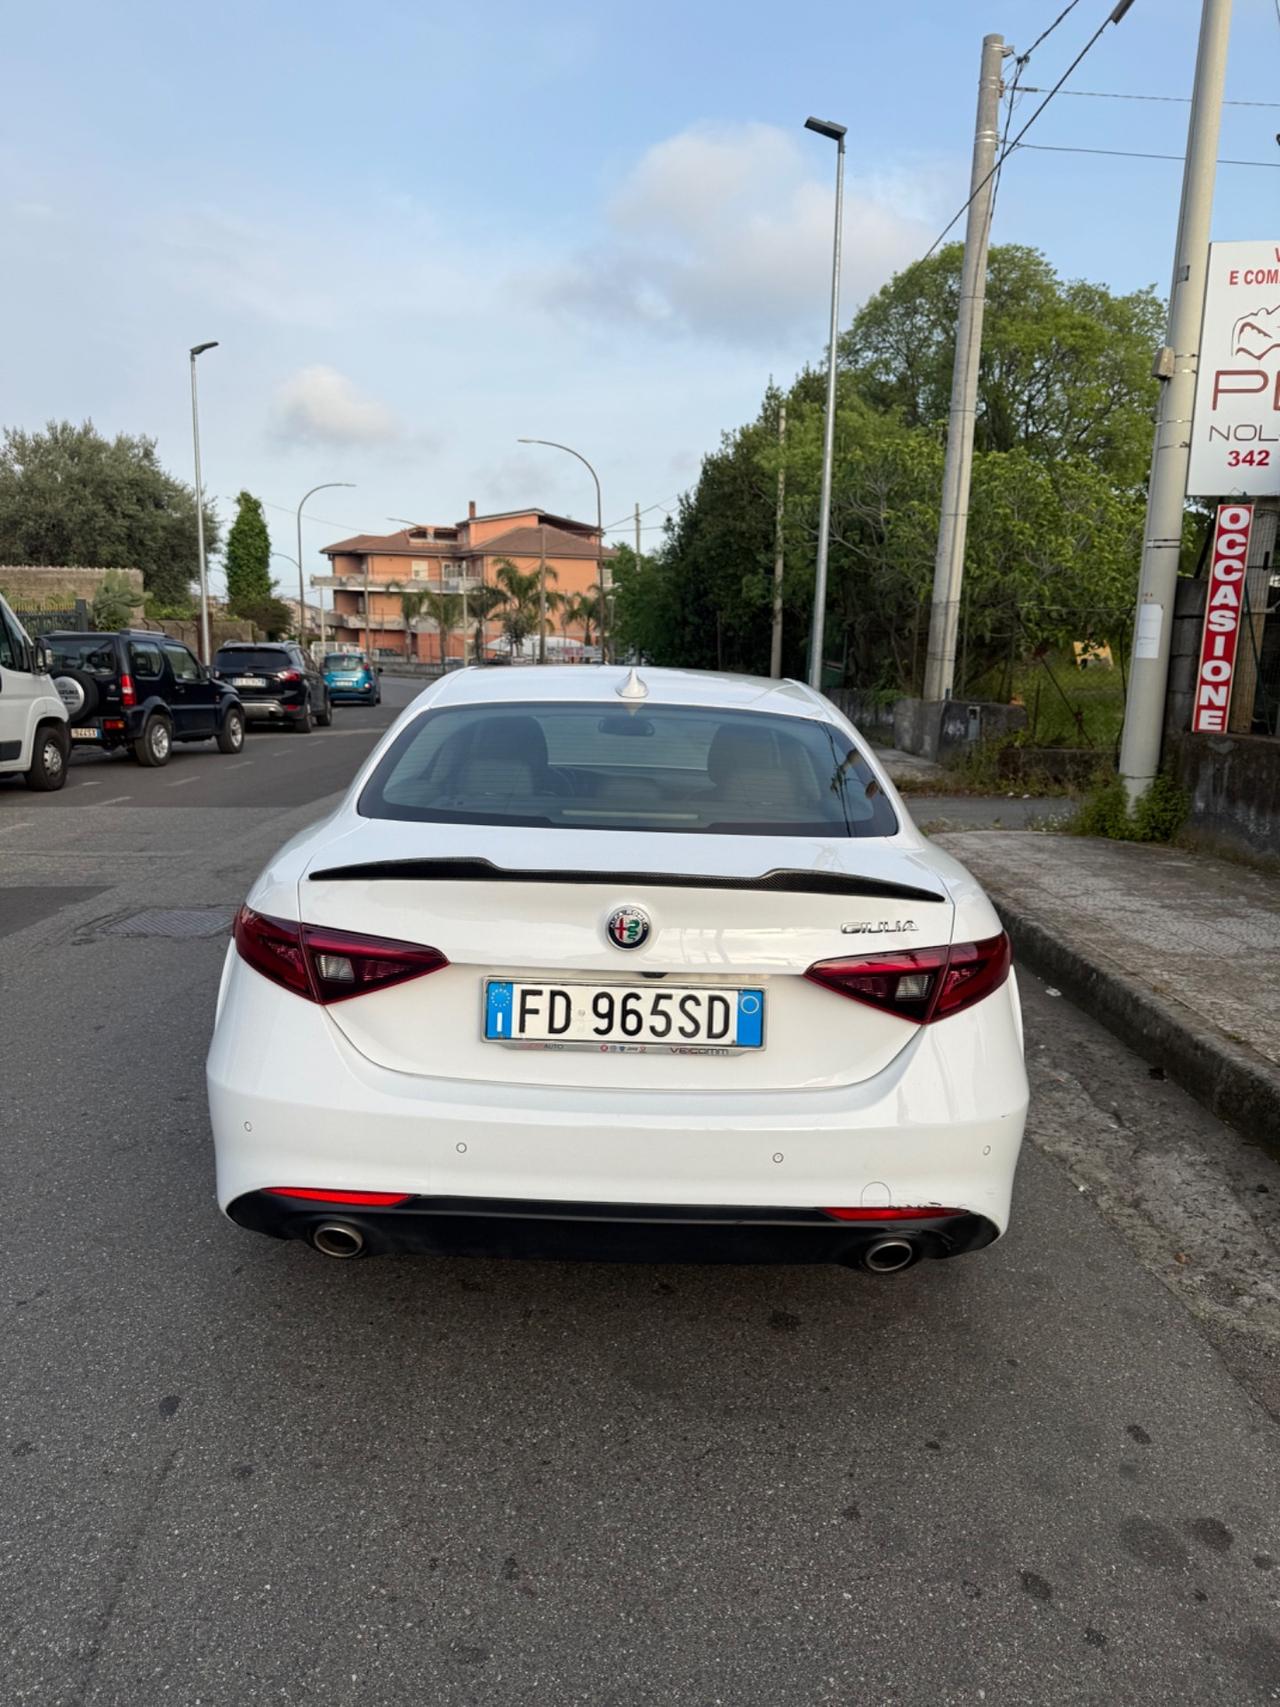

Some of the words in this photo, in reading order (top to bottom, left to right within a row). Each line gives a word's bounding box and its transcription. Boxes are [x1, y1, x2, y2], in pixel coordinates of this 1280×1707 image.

[1229, 270, 1240, 285] E
[1243, 269, 1280, 285] COM
[1212, 369, 1280, 411] P
[1208, 424, 1280, 442] NOL
[1227, 449, 1270, 467] 342
[1199, 507, 1250, 731] OCCASIONE
[840, 920, 919, 934] GIULIA
[518, 989, 572, 1035] FD
[592, 991, 730, 1039] 965SD
